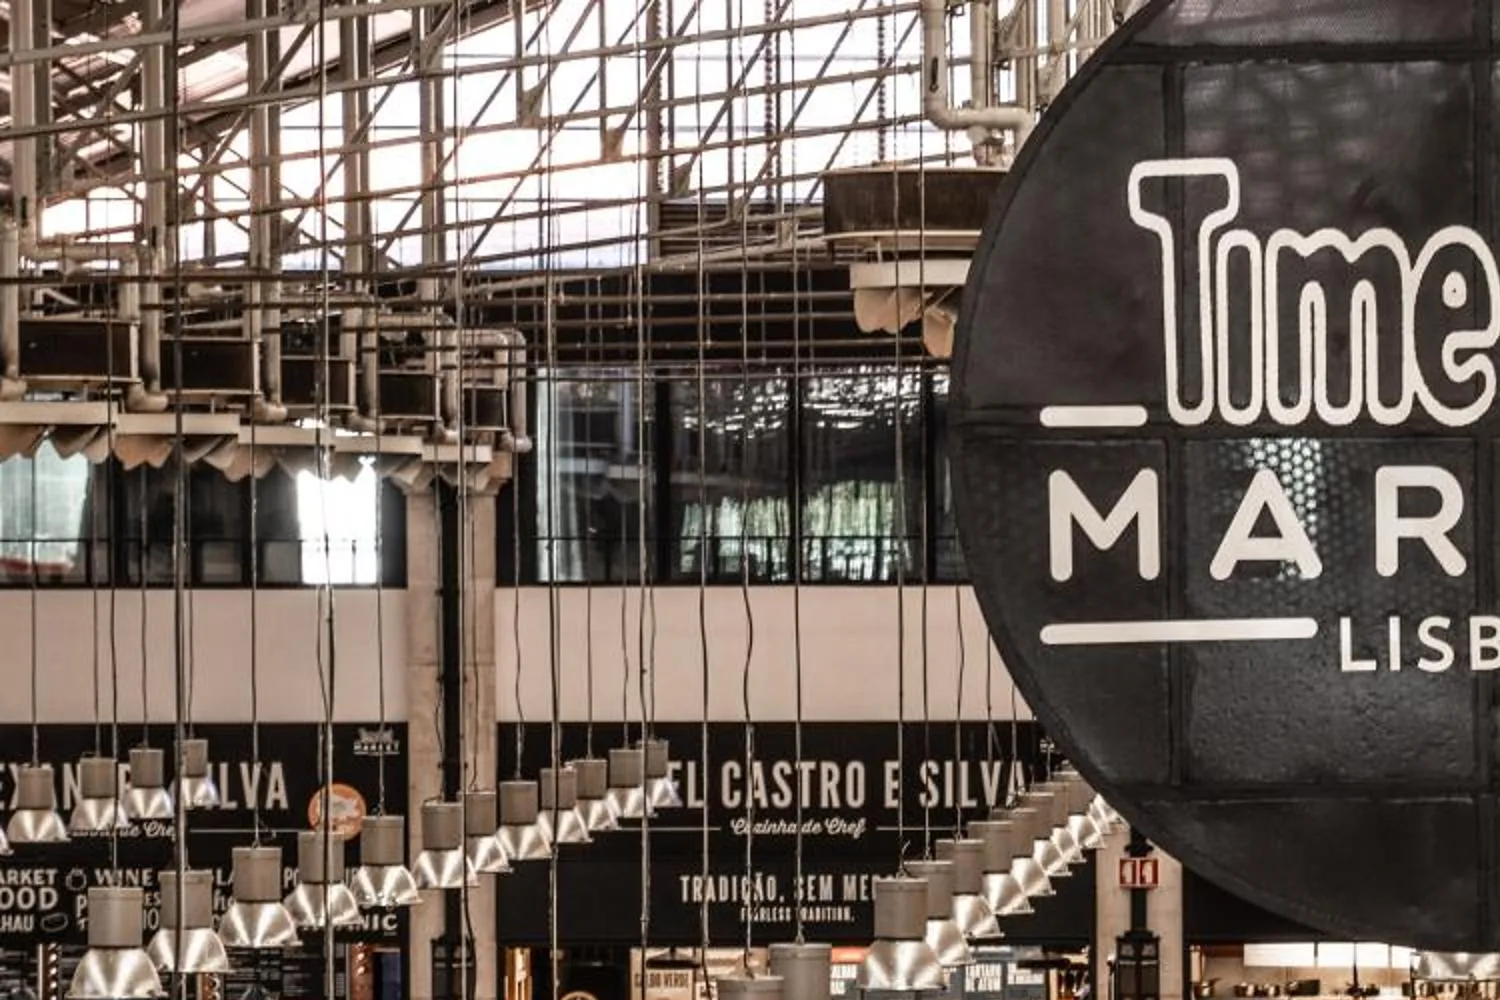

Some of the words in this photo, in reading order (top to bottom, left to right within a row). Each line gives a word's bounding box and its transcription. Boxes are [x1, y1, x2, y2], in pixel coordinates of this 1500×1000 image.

[721, 760, 867, 809] CASTRO
[884, 760, 900, 808] E
[919, 760, 1025, 808] SILVA
[730, 817, 797, 835] Cozinha
[800, 817, 823, 834] de
[824, 816, 867, 839] Chef
[95, 868, 153, 887] WINE
